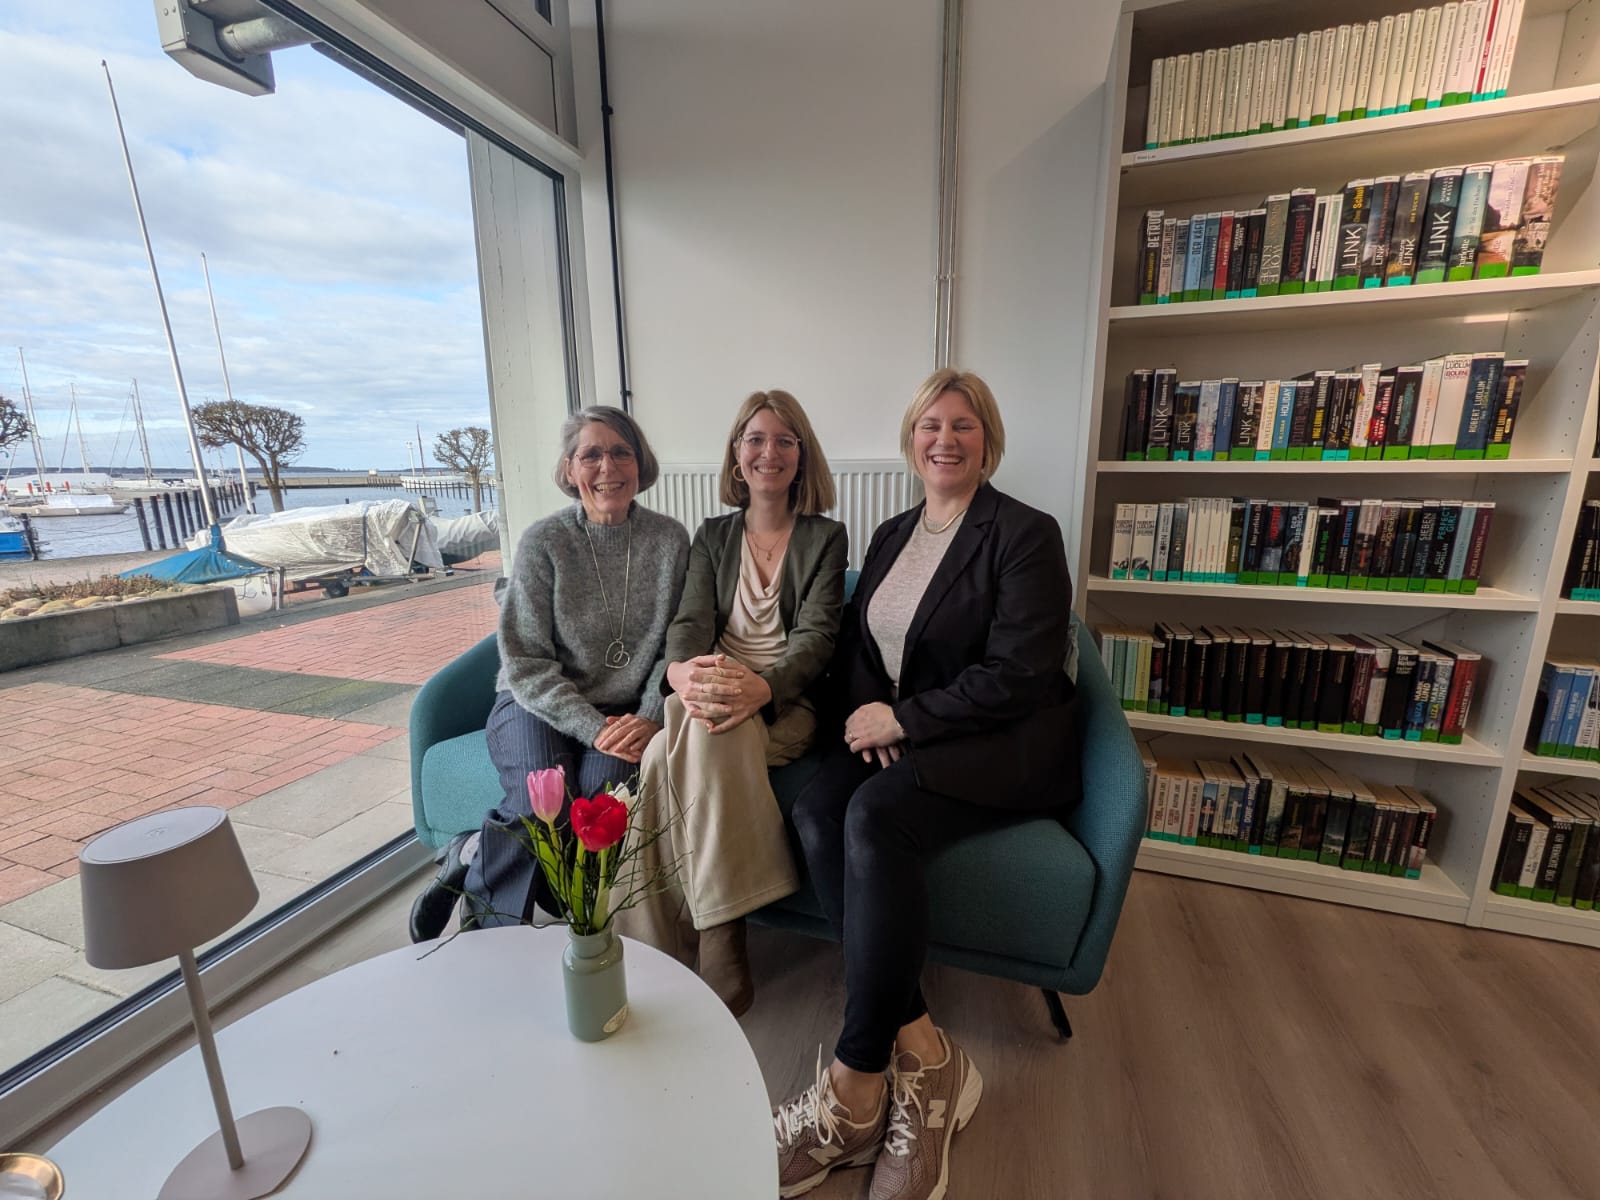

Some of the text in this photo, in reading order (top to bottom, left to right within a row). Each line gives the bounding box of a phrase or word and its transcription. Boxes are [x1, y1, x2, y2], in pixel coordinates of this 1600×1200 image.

[1428, 212, 1452, 254] LINK
[1342, 227, 1362, 267] LINK
[1375, 244, 1385, 265] LINK
[1403, 238, 1415, 265] LINK
[1280, 388, 1293, 417] HOLIDAY
[1153, 407, 1168, 440] LINK
[1179, 421, 1191, 443] LINK
[1239, 419, 1253, 445] LINK
[1419, 513, 1431, 541] SIEBEN
[1446, 514, 1456, 532] GIRL
[1430, 704, 1439, 719] LIZA
